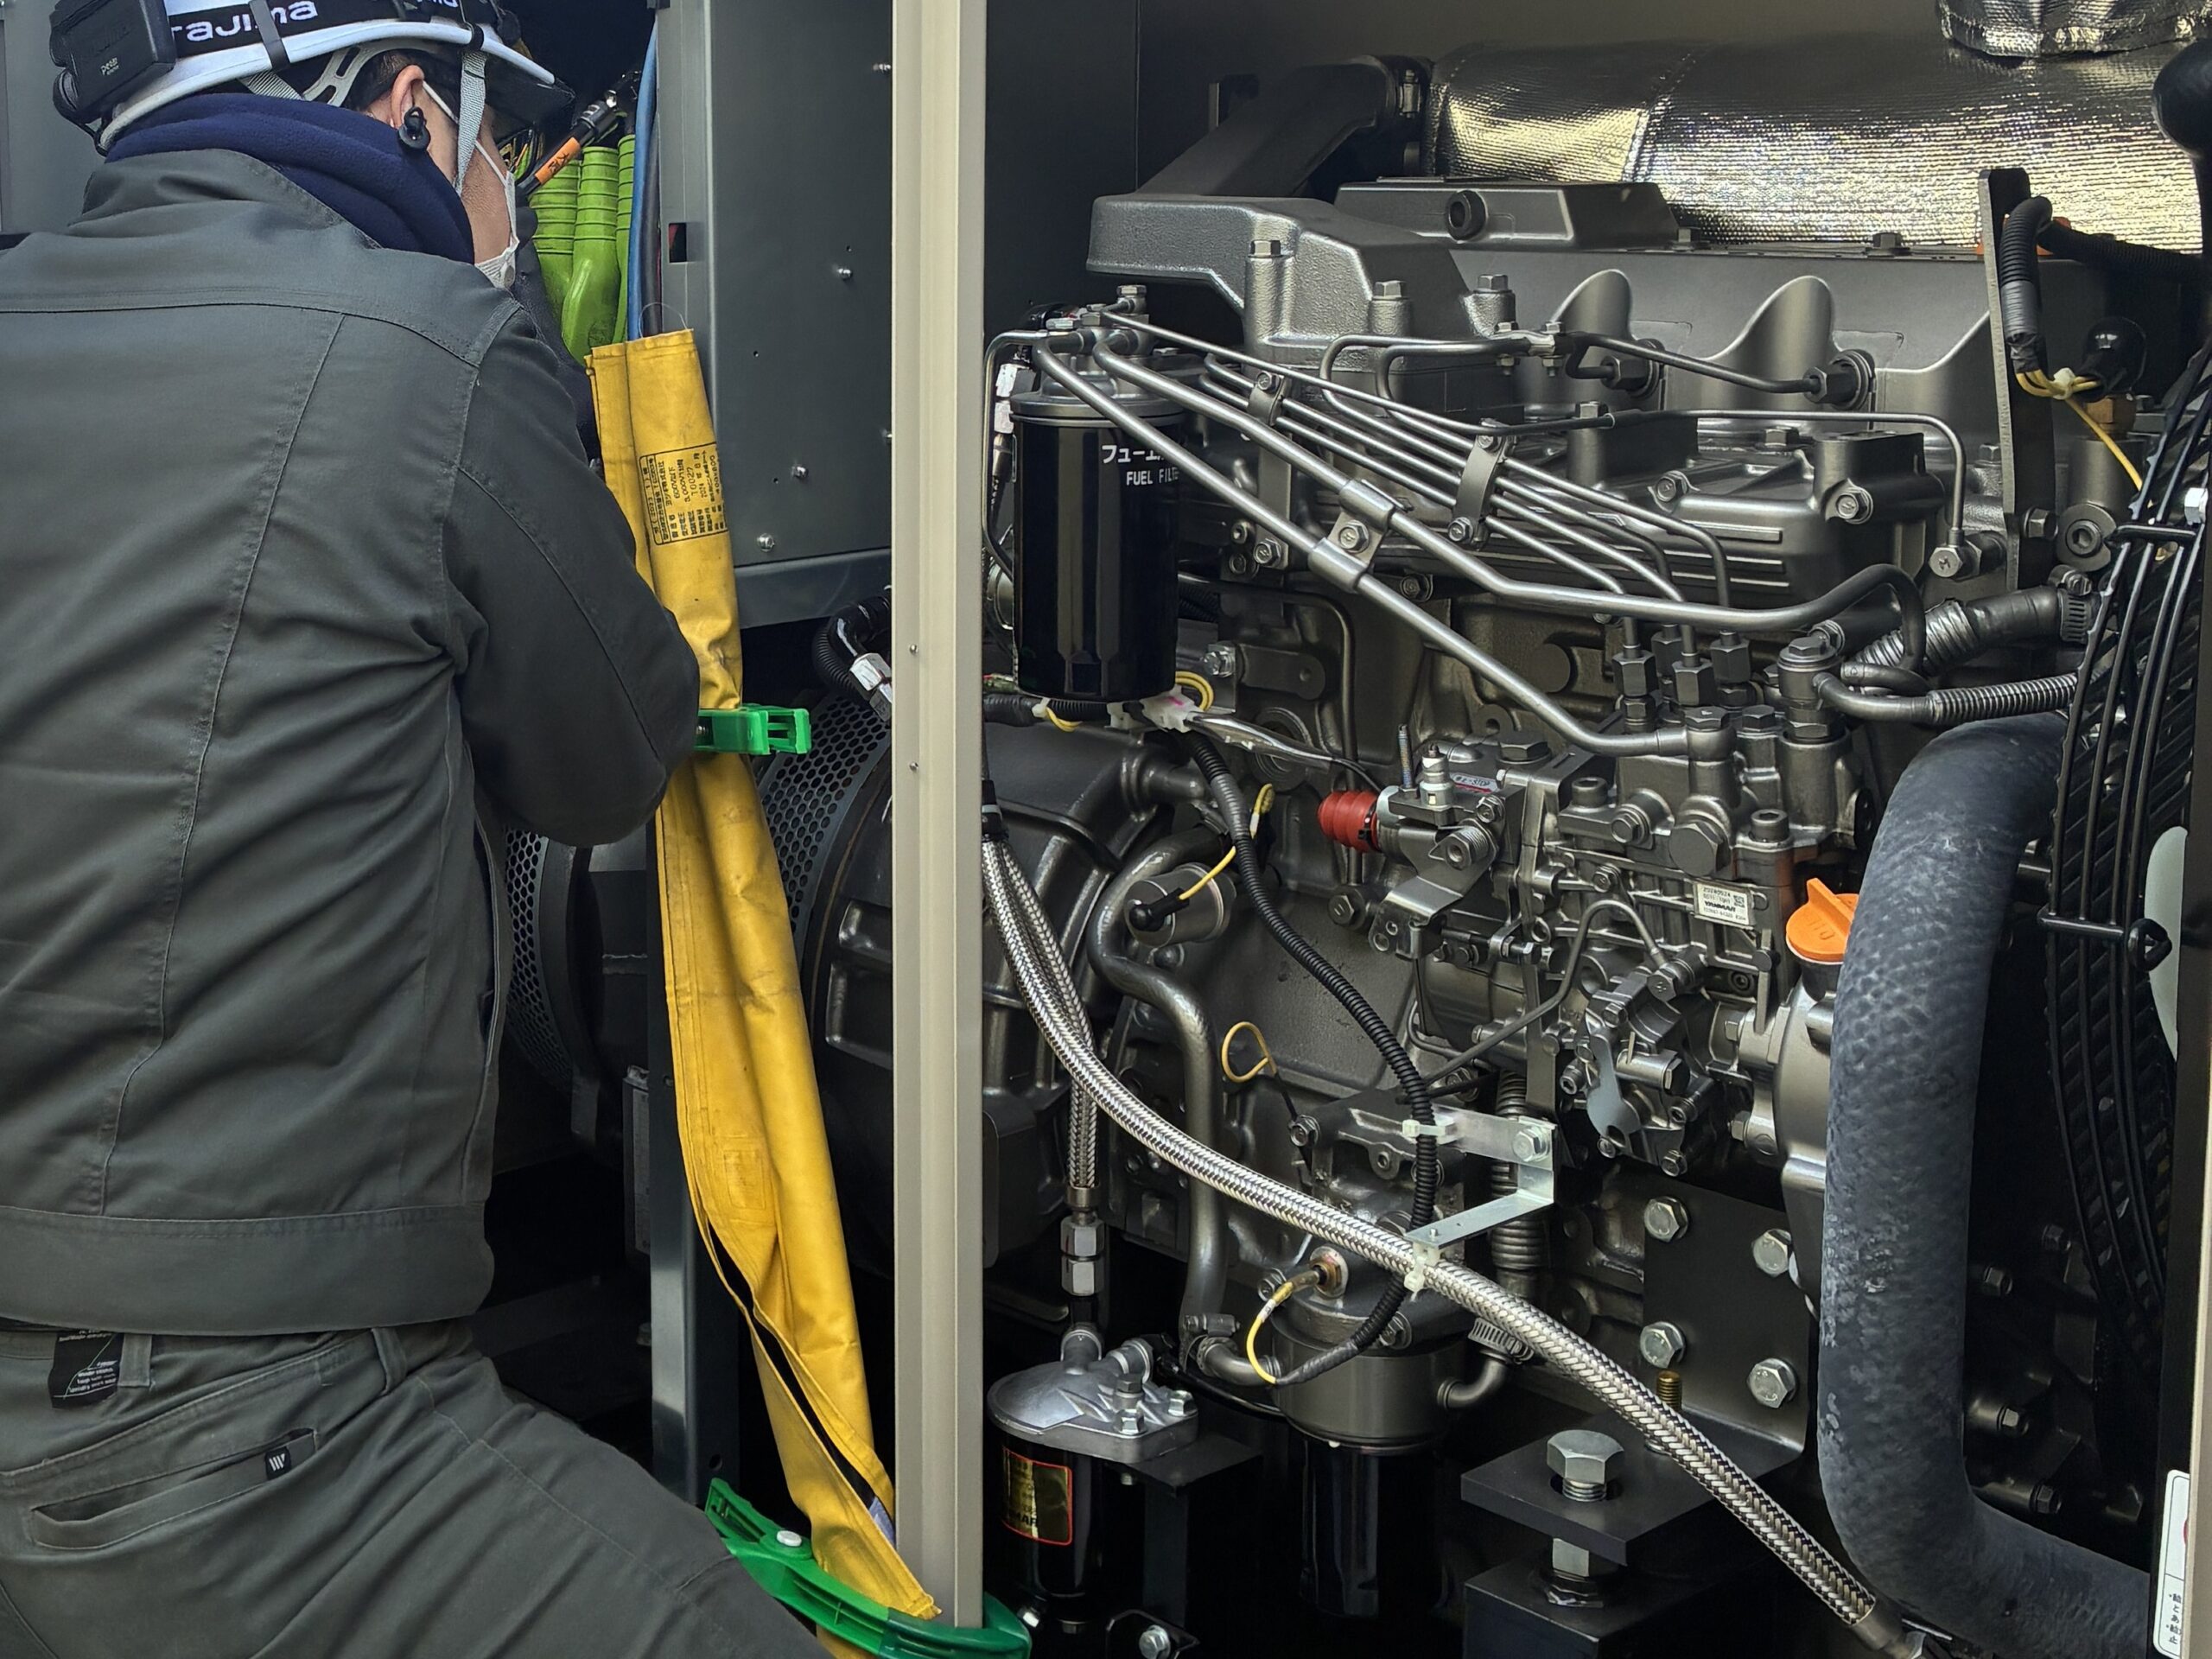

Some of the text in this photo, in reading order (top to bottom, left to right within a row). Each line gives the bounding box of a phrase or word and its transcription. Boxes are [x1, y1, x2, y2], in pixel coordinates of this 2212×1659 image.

[1102, 445, 1164, 464] フューエ
[1126, 470, 1153, 486] FUEL
